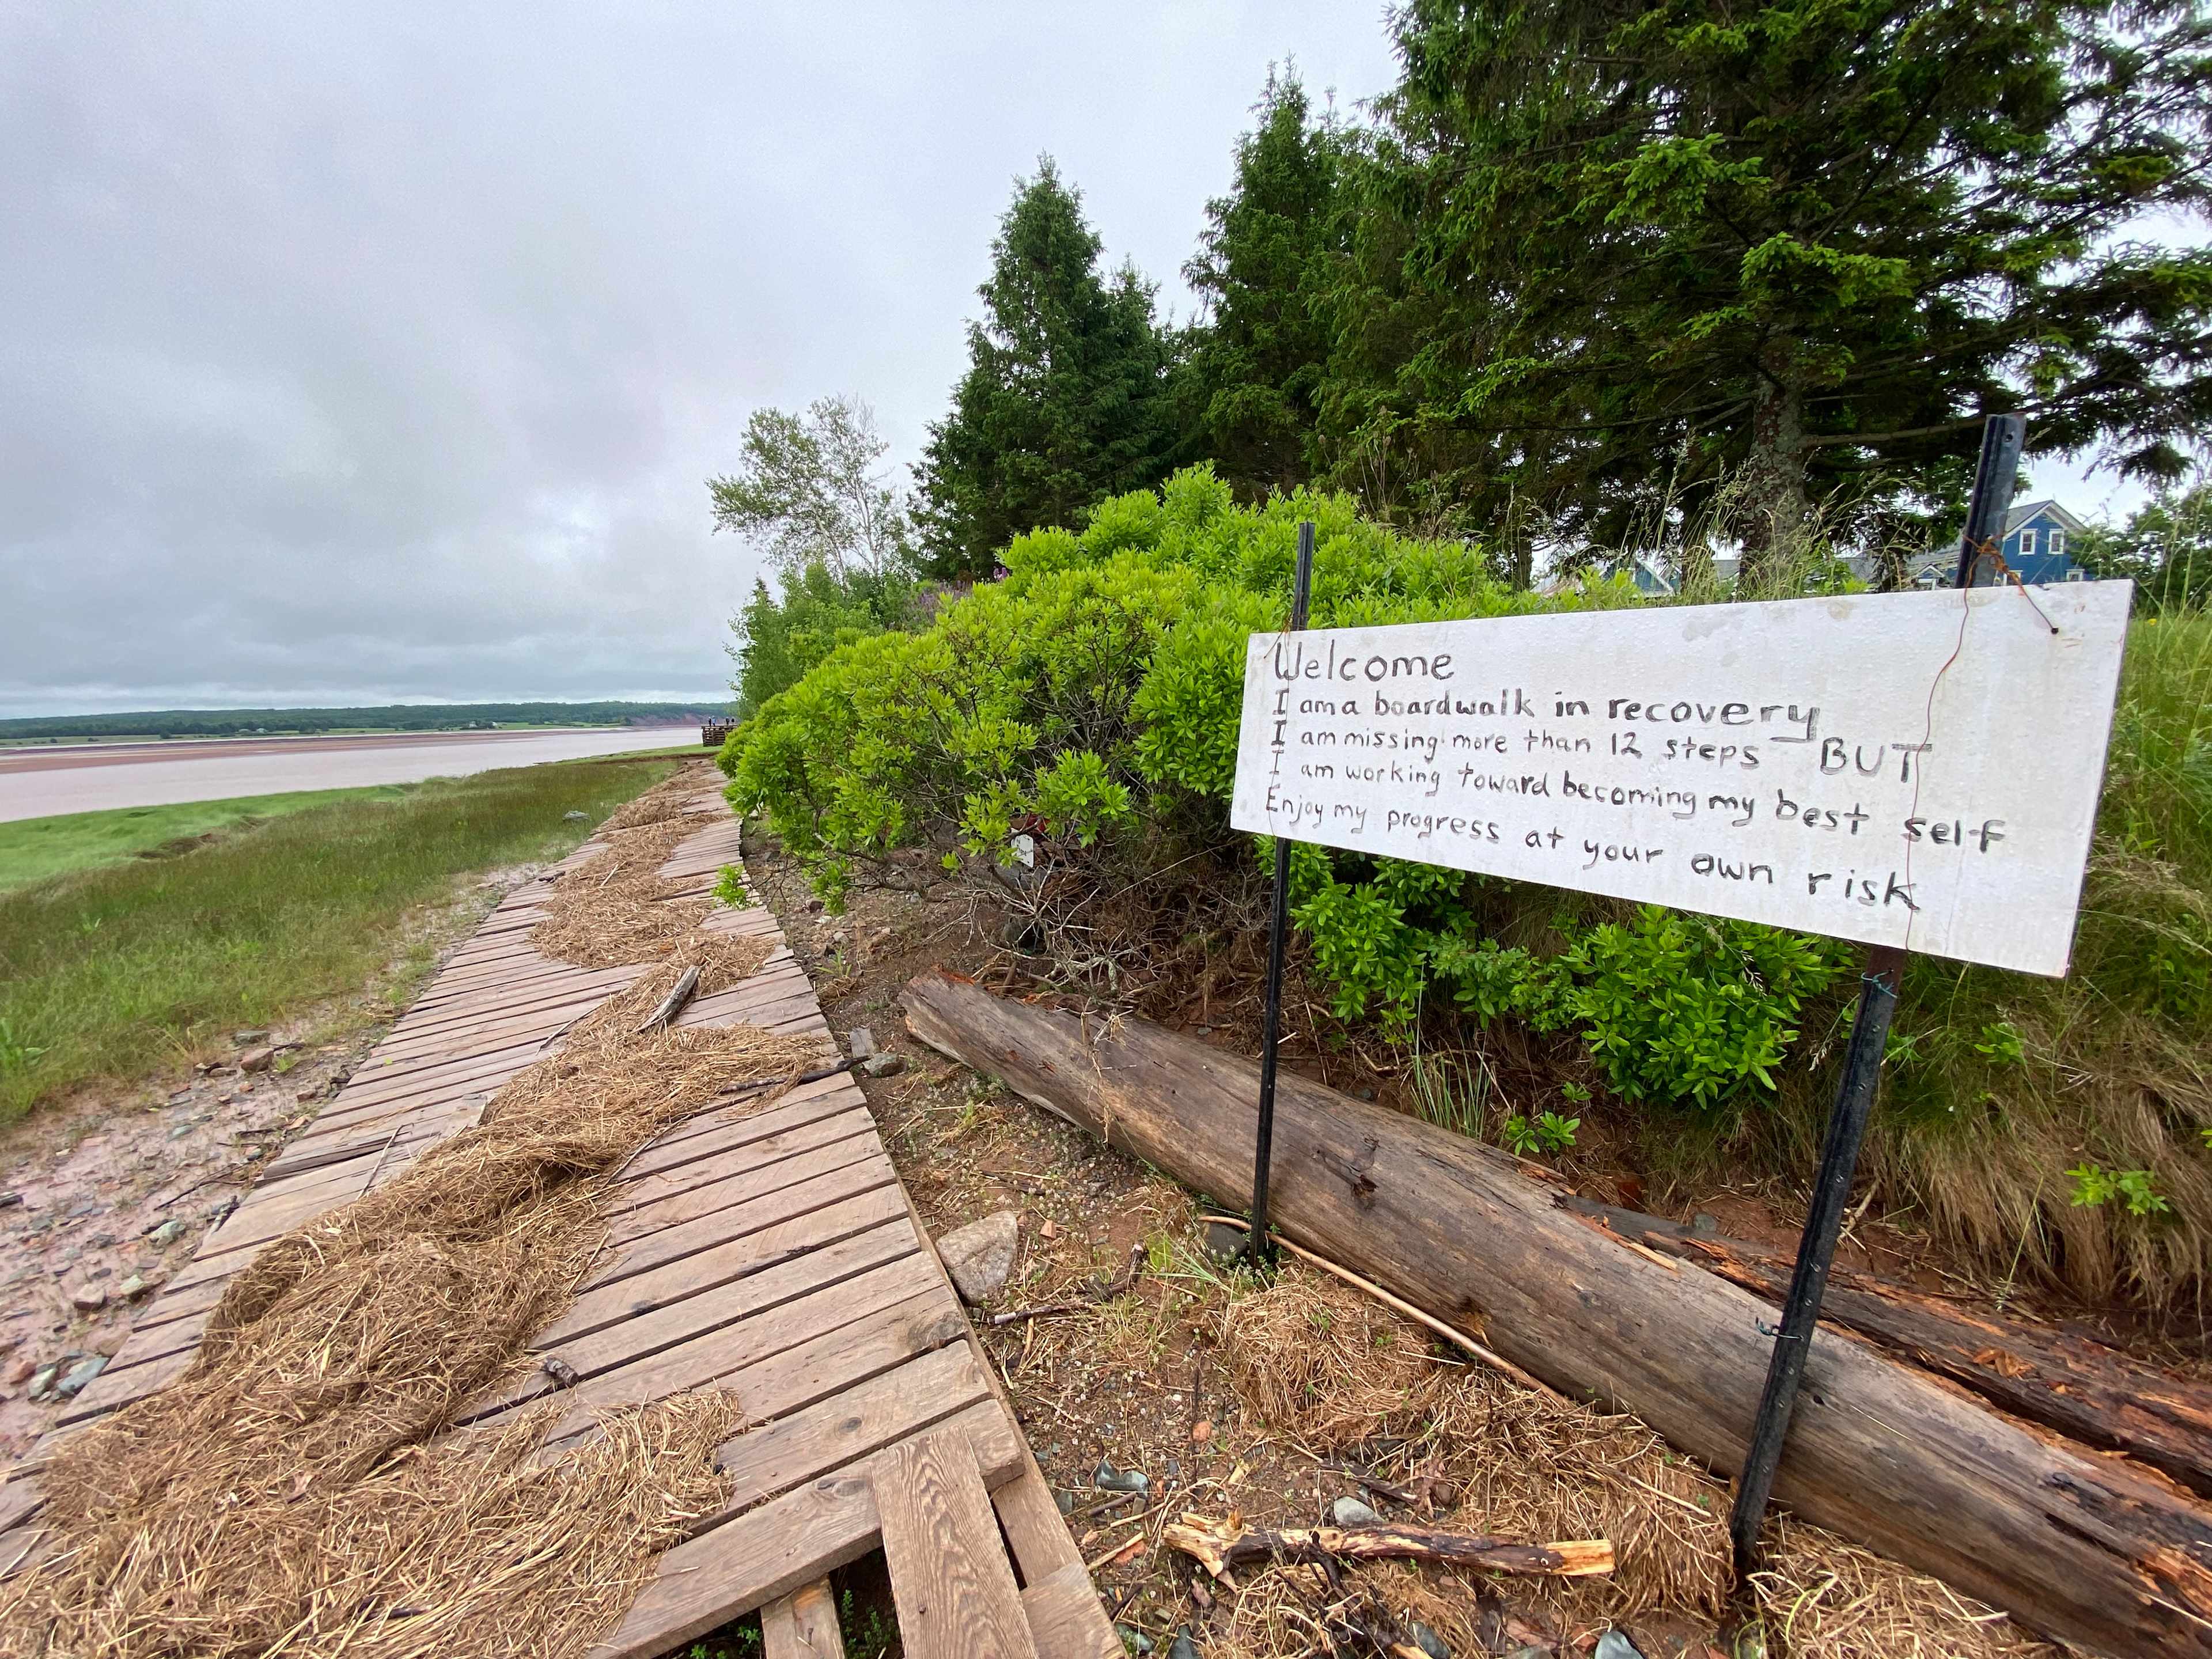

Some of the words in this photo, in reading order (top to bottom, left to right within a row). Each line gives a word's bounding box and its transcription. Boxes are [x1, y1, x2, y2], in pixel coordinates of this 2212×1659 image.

[1275, 639, 1455, 681] Welcome
[1272, 688, 1289, 714] I
[1300, 699, 1335, 715] am
[1375, 688, 1535, 717] boardwalk
[1555, 691, 1589, 717] in
[1608, 698, 1820, 743] recovery
[1271, 721, 1287, 745] I
[1301, 731, 1336, 746] am
[1344, 728, 1438, 763] missing
[1453, 734, 1507, 753] more
[1524, 729, 1590, 752] than
[1612, 732, 1642, 759] 12
[1662, 736, 1759, 769] steps
[1820, 737, 1932, 782] BUT
[1269, 750, 1284, 774] I
[1301, 764, 1334, 779] am
[1346, 761, 1441, 797] working
[1458, 762, 1550, 797] toward
[1563, 770, 1696, 819] becoming
[1709, 794, 1754, 827] my
[1777, 789, 1869, 835] best
[1900, 818, 2005, 853] self
[1266, 784, 1323, 828] Enjoy
[1334, 804, 1367, 834] my
[1388, 809, 1499, 843] progress
[1525, 827, 1565, 849] at
[1583, 839, 1663, 870] your
[1691, 854, 1772, 884] own
[1808, 870, 1920, 912] risk
